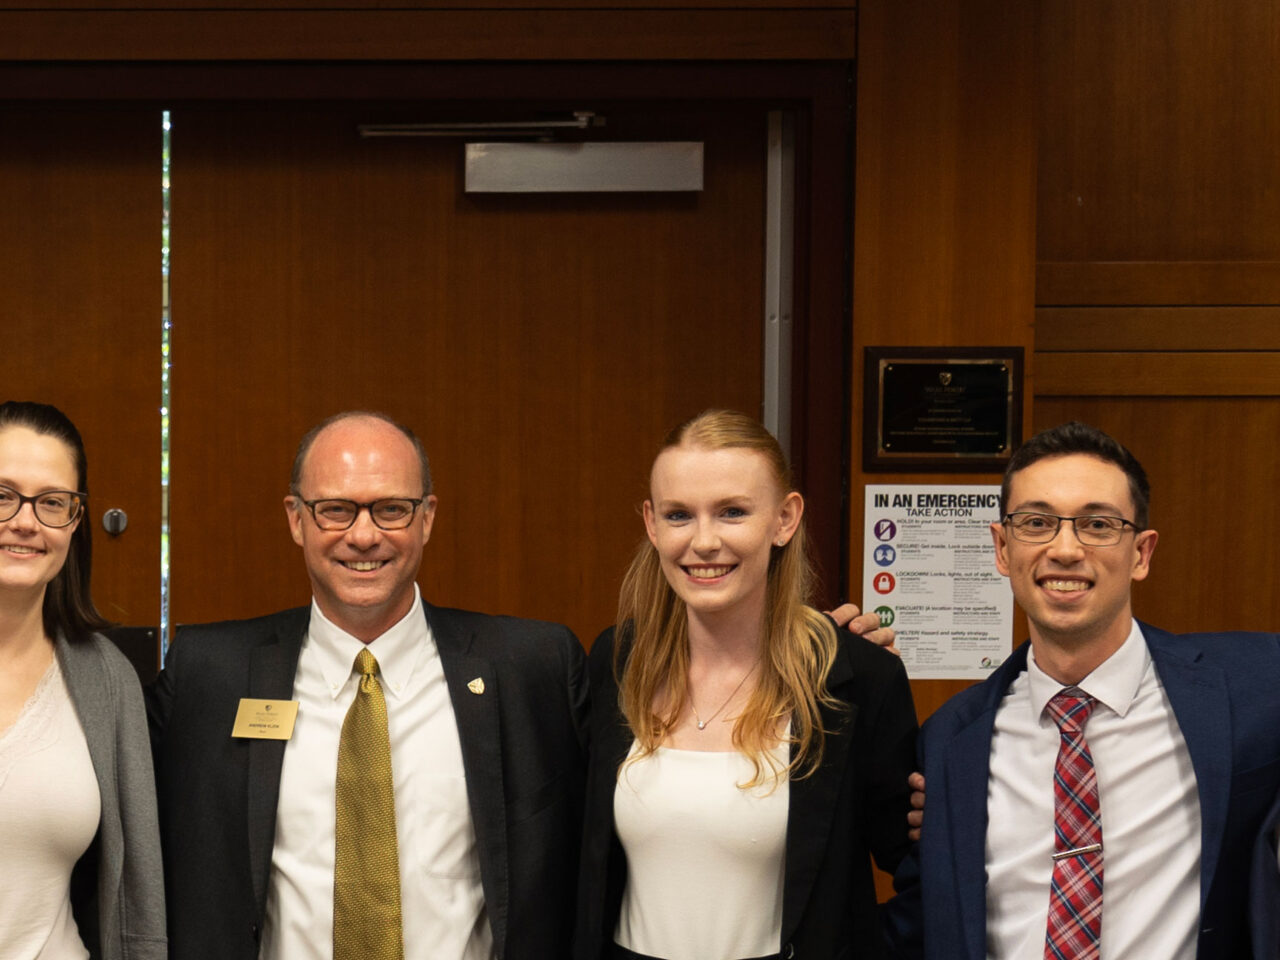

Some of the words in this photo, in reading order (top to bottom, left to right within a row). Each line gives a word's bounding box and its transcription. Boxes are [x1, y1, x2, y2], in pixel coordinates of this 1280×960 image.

[874, 494, 889, 508] IN
[892, 494, 913, 508] AN
[906, 508, 931, 517] TAKE
[934, 508, 973, 517] ACTION
